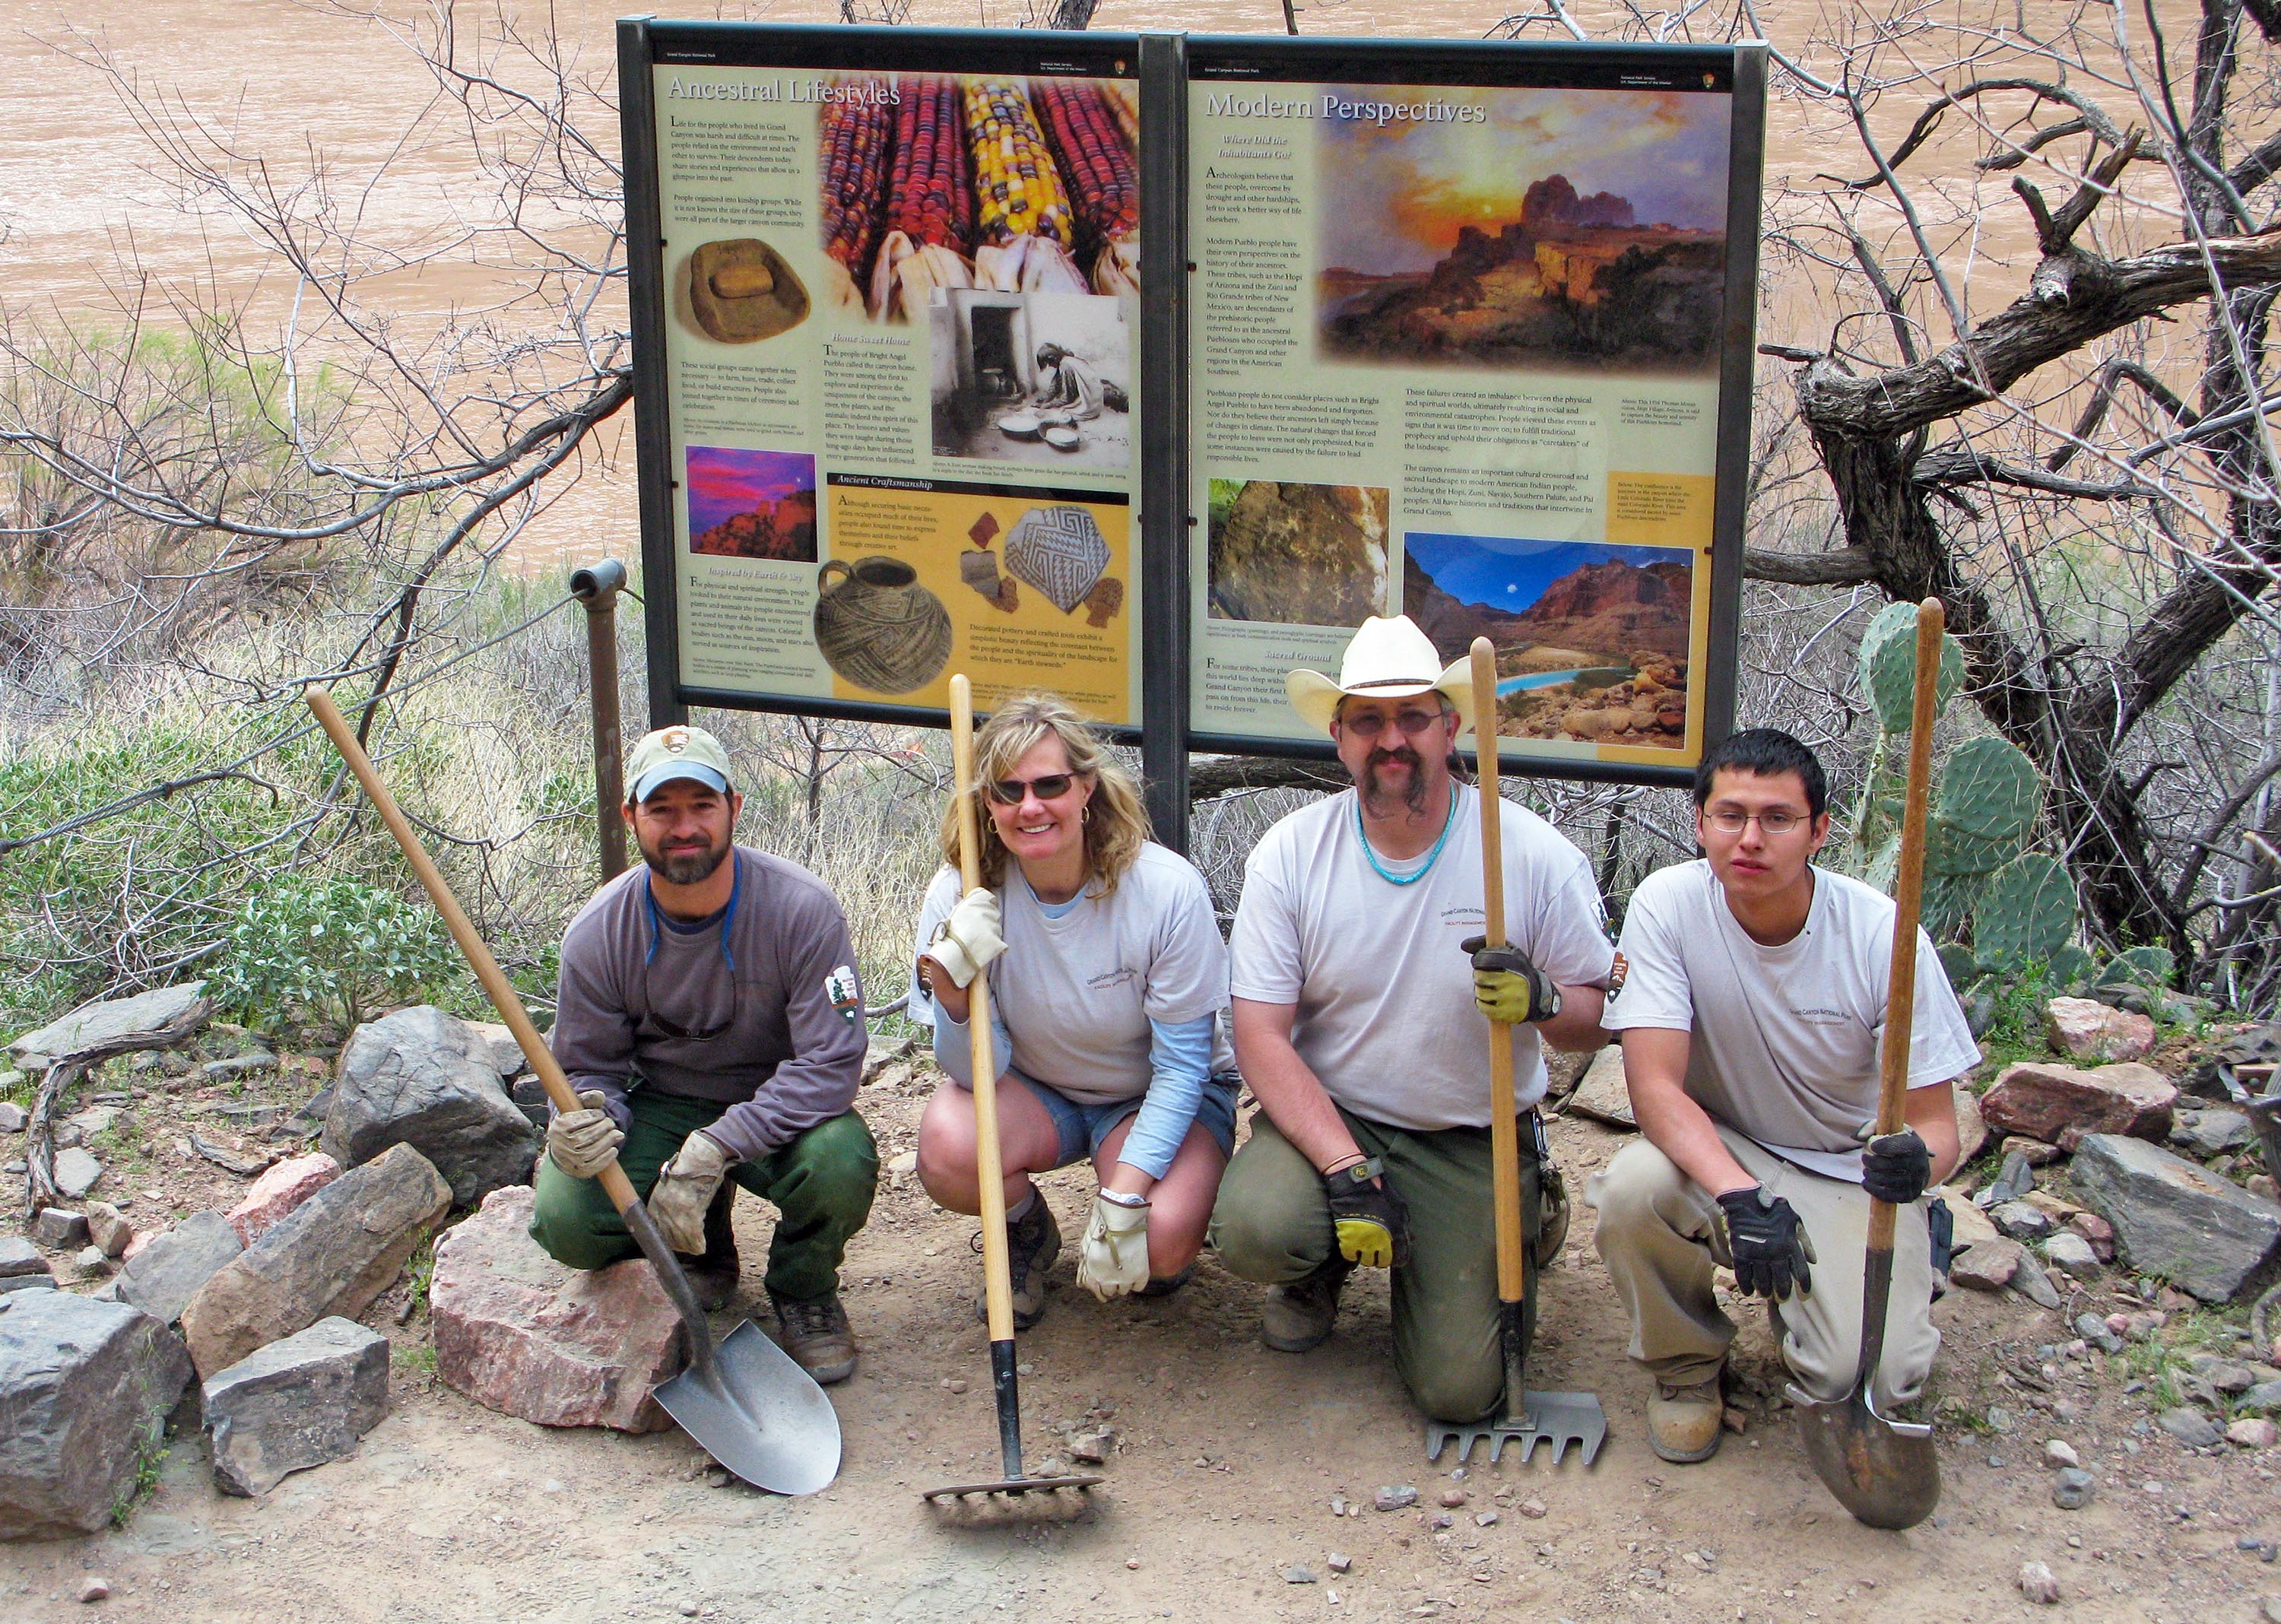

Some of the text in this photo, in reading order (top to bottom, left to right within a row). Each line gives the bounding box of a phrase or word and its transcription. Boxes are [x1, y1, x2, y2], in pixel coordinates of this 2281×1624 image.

[668, 78, 900, 110] Ancestral Lifestyles
[1207, 93, 1486, 127] Modern Perspectives
[1223, 136, 1287, 145] Where Did the
[1219, 150, 1291, 159] Inhabitants Go?
[1206, 168, 1255, 182] Archeologists
[1283, 184, 1290, 193] by
[1206, 192, 1231, 202] drought
[1258, 239, 1280, 249] people
[1239, 250, 1278, 259] perspectives
[1207, 259, 1228, 268] history
[1239, 259, 1254, 268] their
[1285, 272, 1302, 282] Hopi
[1214, 281, 1239, 289] Arizona
[1245, 303, 1284, 312] descendants
[1218, 314, 1252, 324] prehistoric
[1254, 315, 1276, 325] people
[1261, 326, 1290, 335] ancestral
[1207, 335, 1239, 344] Puebloans
[1256, 337, 1286, 347] occupied
[1229, 347, 1253, 357] Canyon
[1207, 357, 1229, 366] regions
[1251, 358, 1282, 366] American
[1207, 389, 1236, 397] Puebloan
[1238, 390, 1259, 400] people
[1283, 392, 1311, 401] consider
[1313, 393, 1333, 404] places
[1359, 395, 1378, 406] Bright
[1451, 390, 1476, 398] created
[1487, 392, 1521, 400] imbalance
[1522, 393, 1550, 401] between
[1565, 395, 1591, 405] physical
[838, 474, 932, 491] Ancient Craftsmanship
[1265, 649, 1331, 662] Sacred Ground
